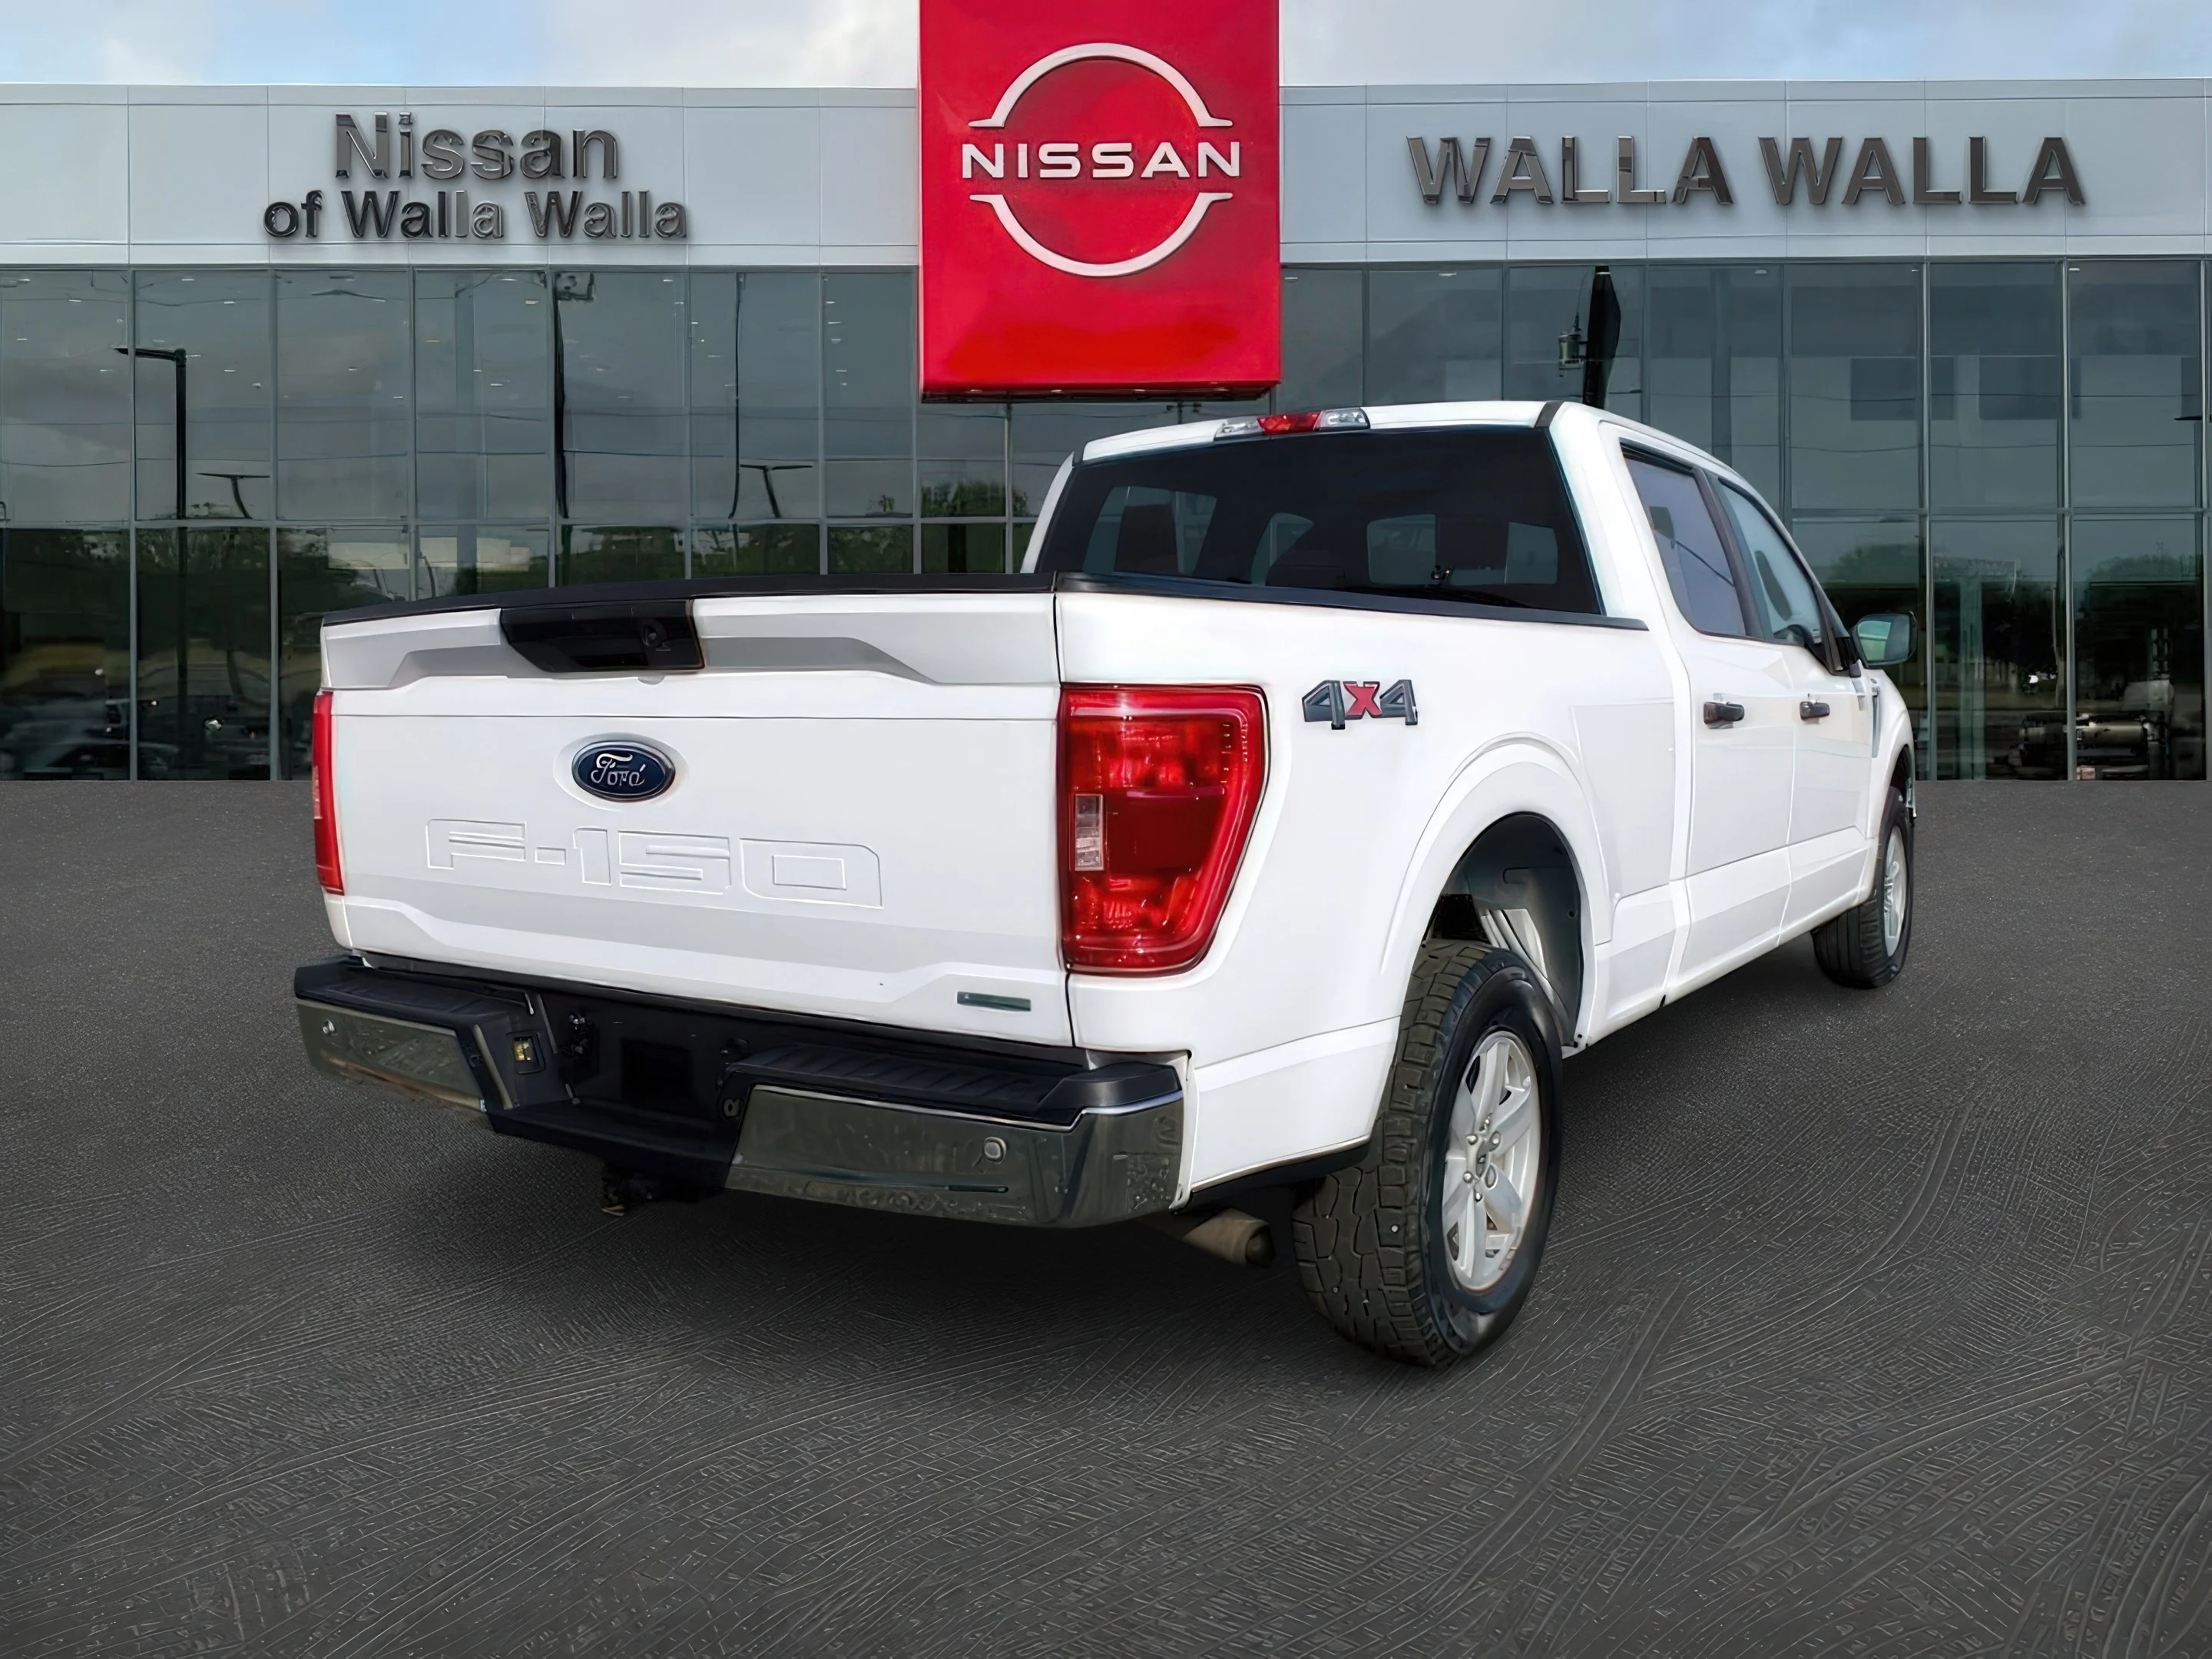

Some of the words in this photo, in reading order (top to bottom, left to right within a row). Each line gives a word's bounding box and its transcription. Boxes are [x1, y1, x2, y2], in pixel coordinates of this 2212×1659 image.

[334, 111, 619, 180] Nissan
[962, 142, 1240, 179] NISSAN
[1406, 135, 1734, 206] WALLA
[1757, 135, 2085, 206] WALLA
[263, 190, 325, 238] of
[340, 190, 504, 239] Walla
[524, 190, 687, 239] Walla
[590, 753, 646, 787] Ford
[426, 818, 883, 909] F-150
